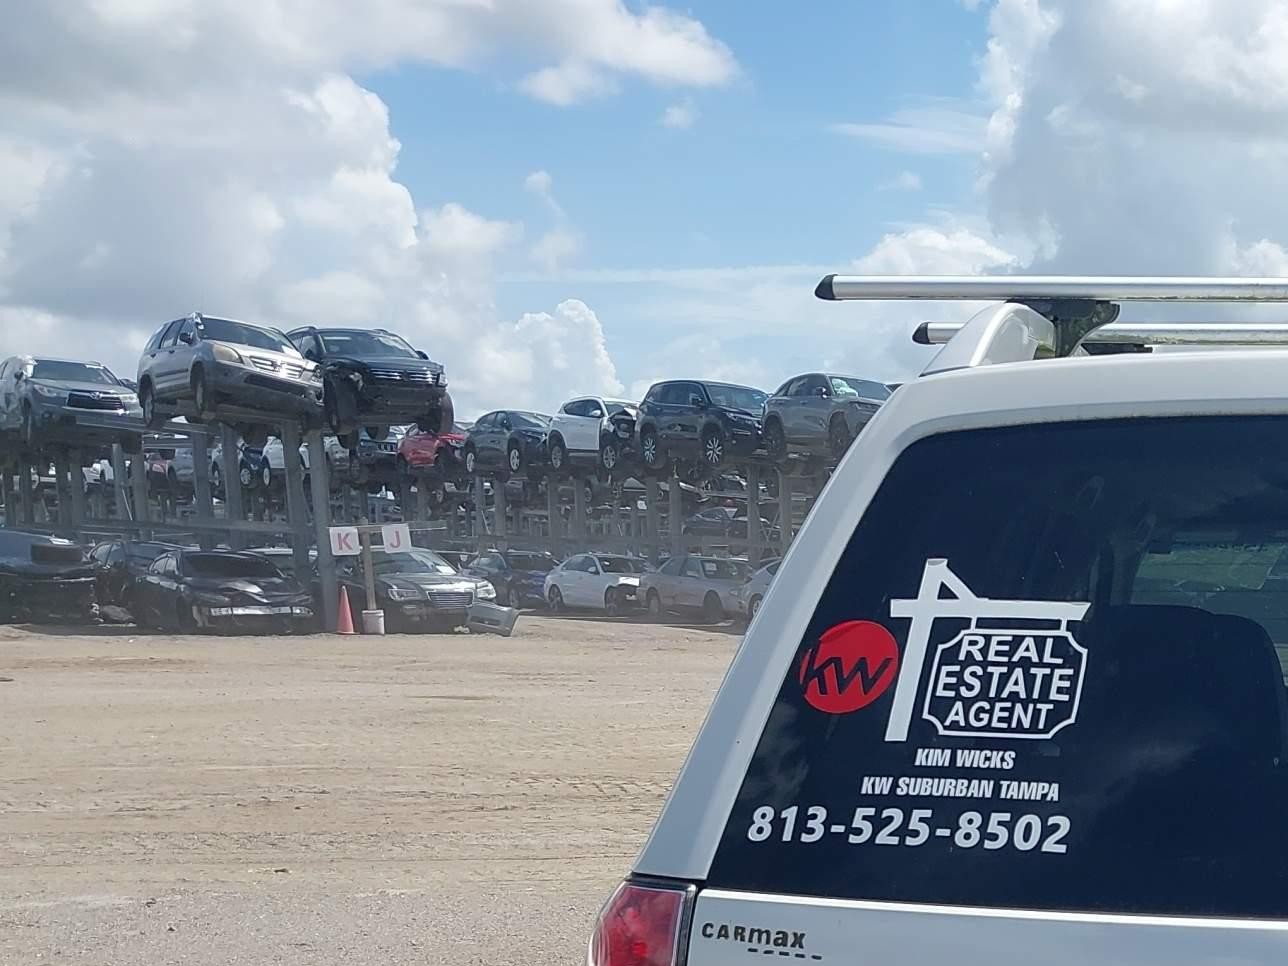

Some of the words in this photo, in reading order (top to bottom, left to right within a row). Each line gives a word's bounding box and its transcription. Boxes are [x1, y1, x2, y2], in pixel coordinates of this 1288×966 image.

[337, 532, 353, 551] K
[389, 530, 401, 548] J
[958, 635, 1065, 665] REAL
[935, 665, 1075, 702] ESTATE
[944, 701, 1054, 730] AGENT
[914, 747, 952, 768] KIM
[955, 748, 1016, 770] WICKS
[860, 775, 892, 796] KW
[897, 776, 994, 799] SUBURBAN
[999, 779, 1060, 802] TAMPA
[747, 804, 1072, 854] 813-525-8502
